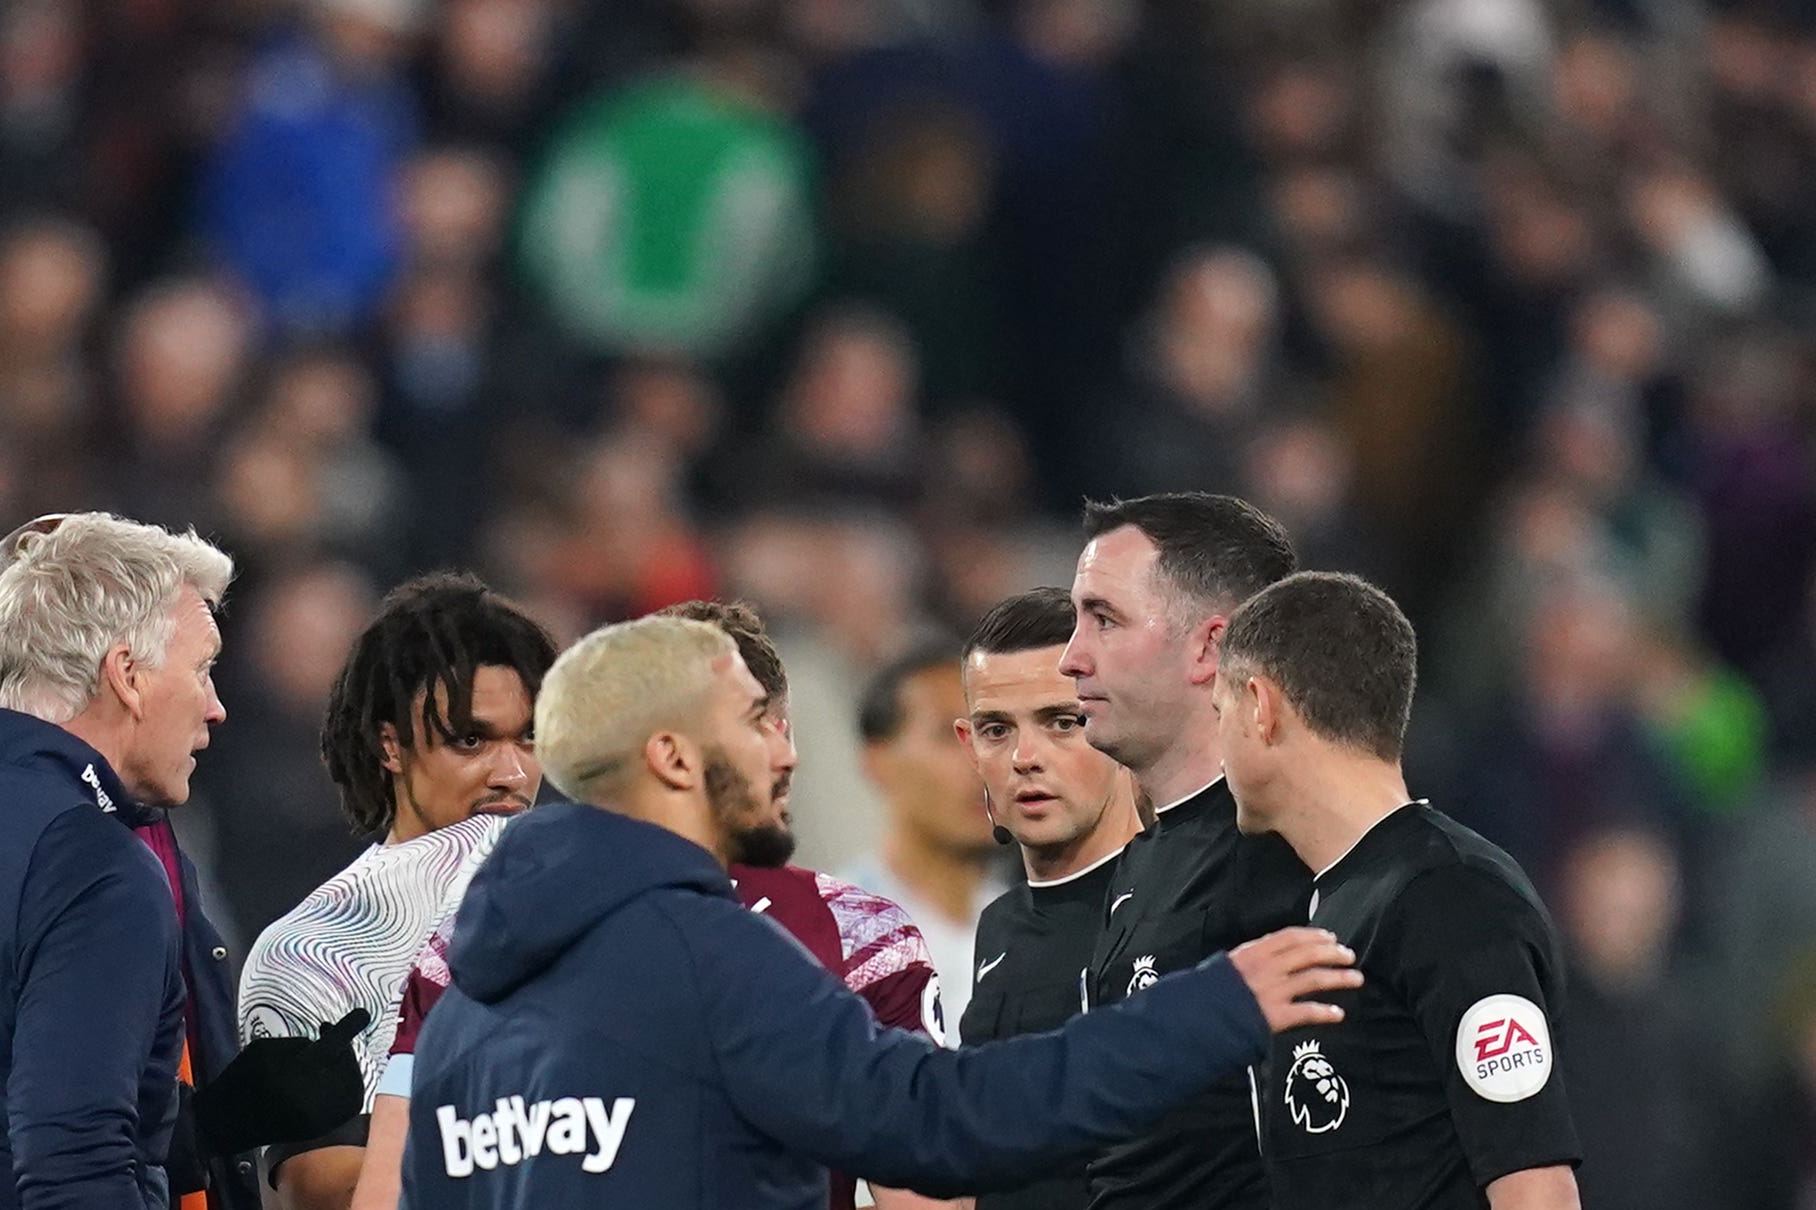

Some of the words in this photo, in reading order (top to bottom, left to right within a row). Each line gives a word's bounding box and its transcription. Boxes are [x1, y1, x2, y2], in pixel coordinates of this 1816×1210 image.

[1474, 1018, 1539, 1062] EA
[1477, 1048, 1544, 1080] SPORTS
[436, 1094, 635, 1178] betway
